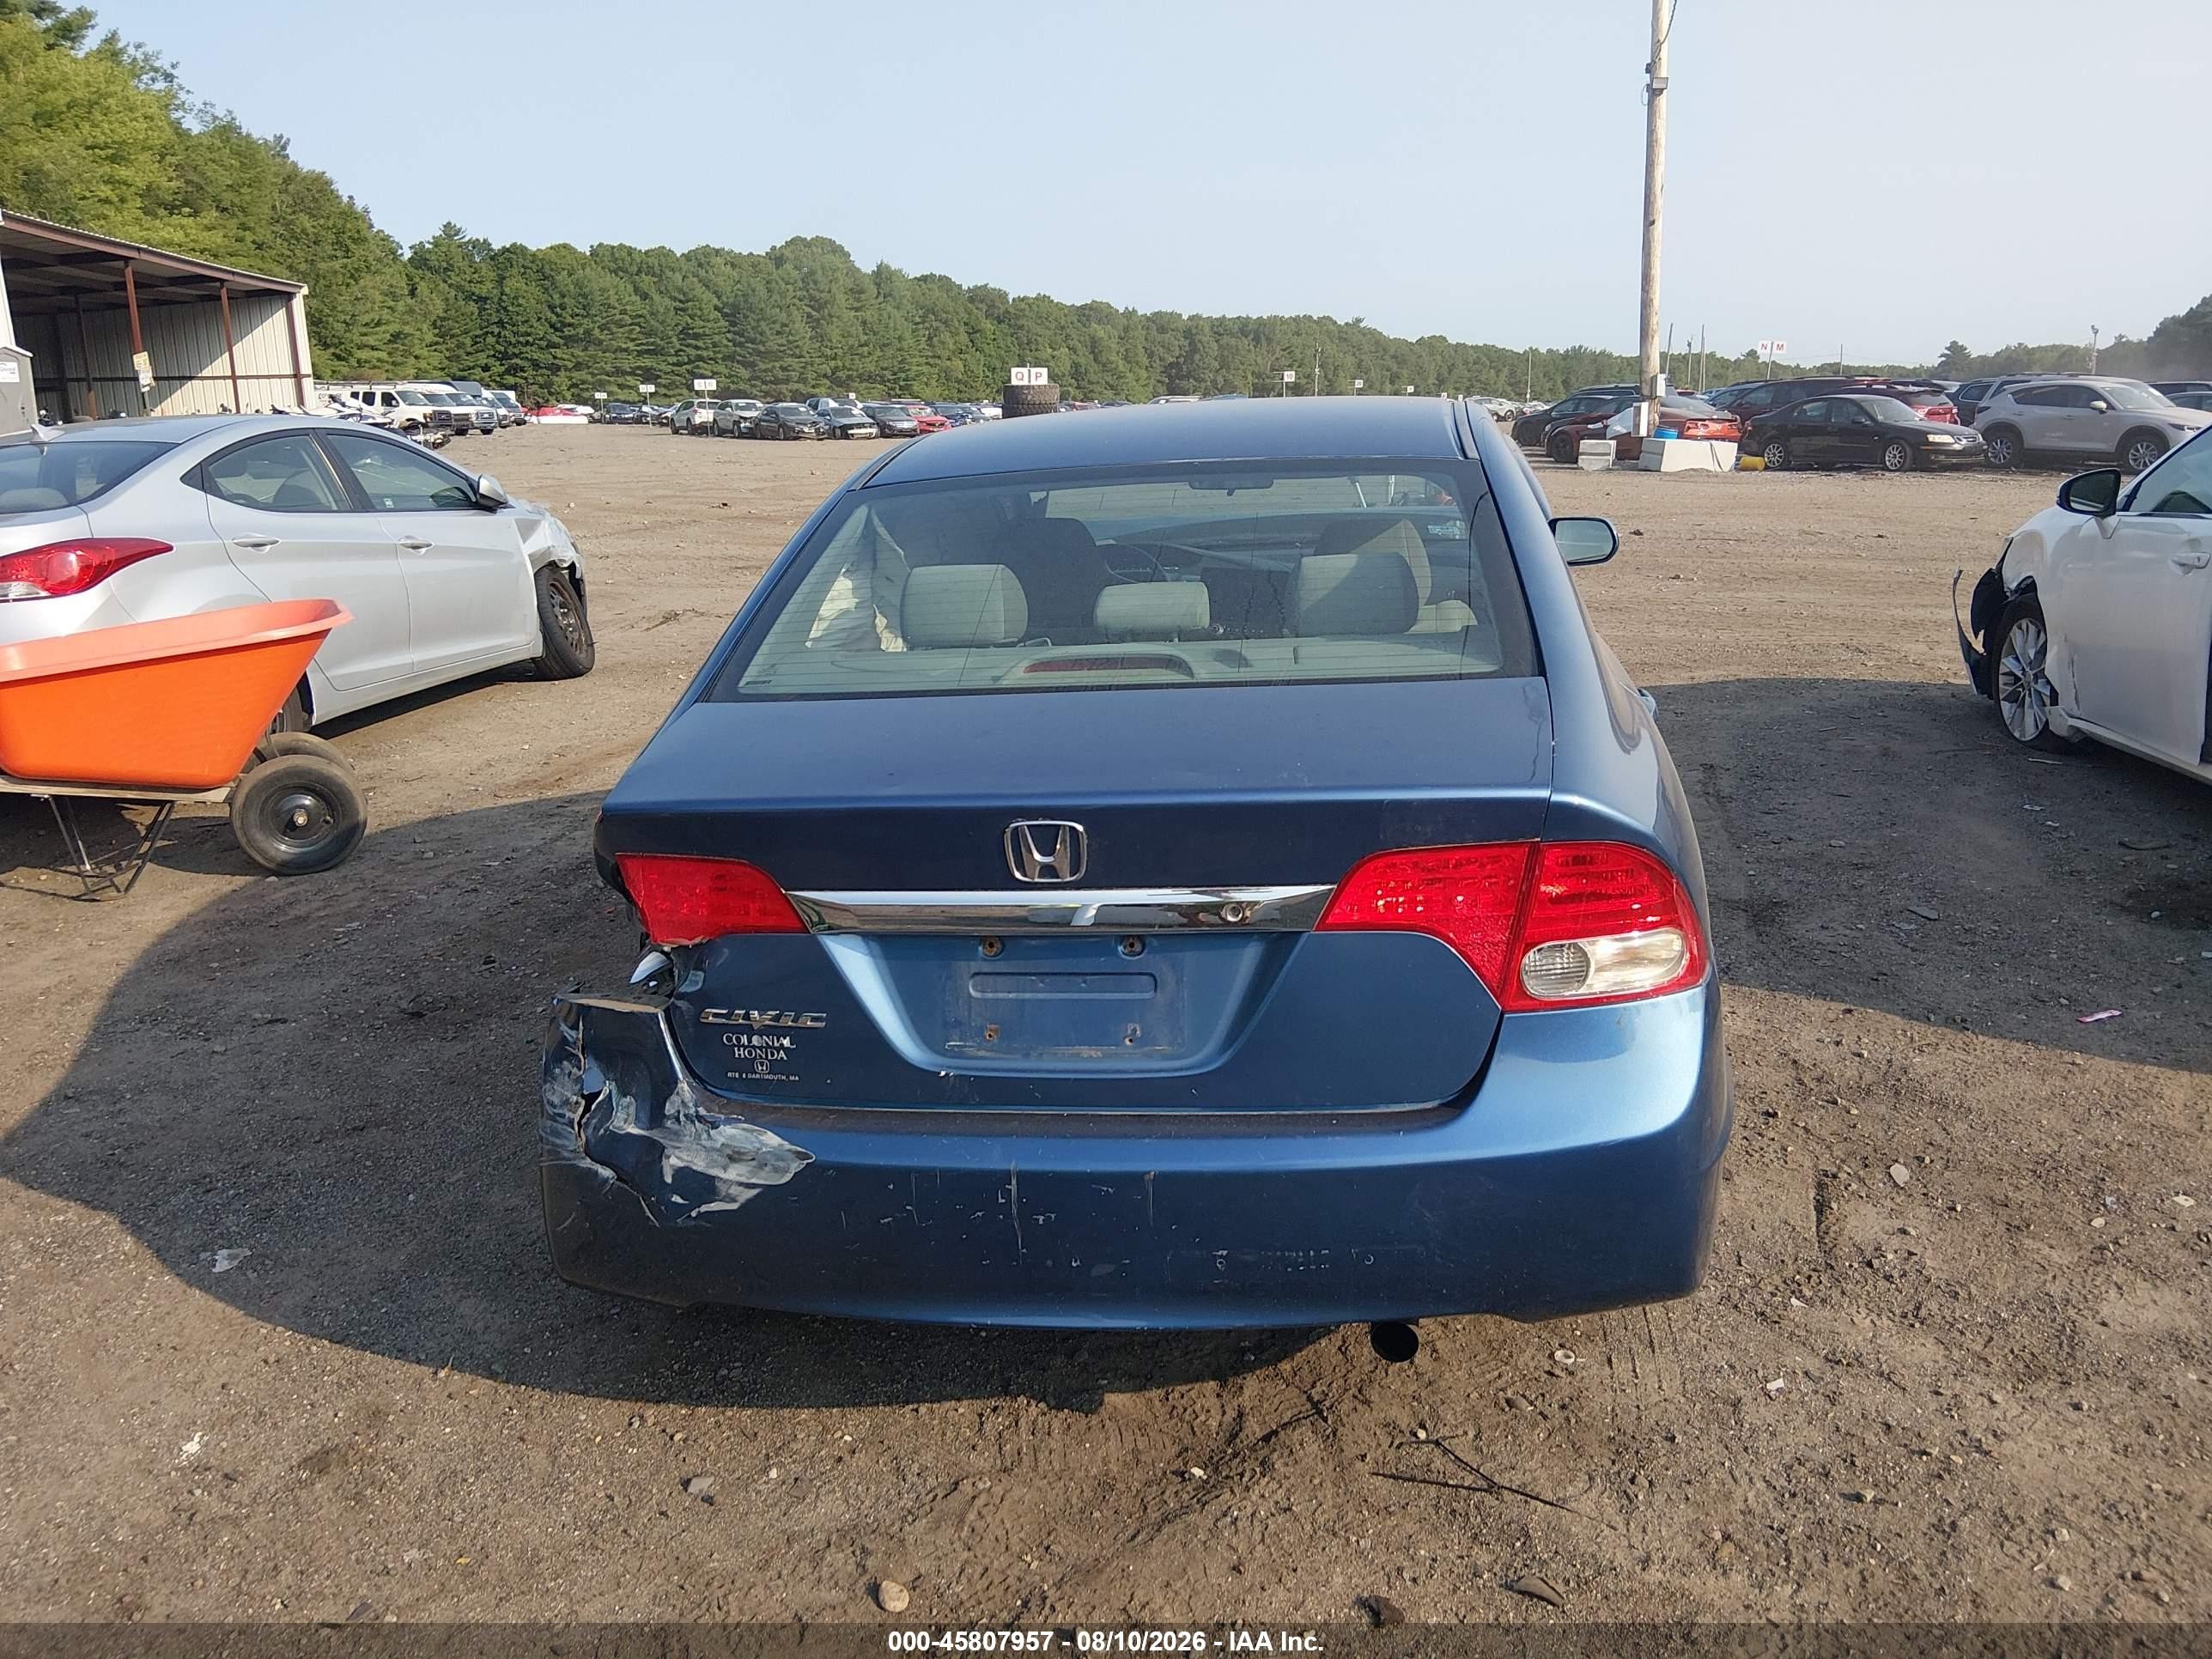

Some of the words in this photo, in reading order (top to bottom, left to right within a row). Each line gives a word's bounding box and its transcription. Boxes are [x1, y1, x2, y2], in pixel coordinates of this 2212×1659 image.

[1015, 371, 1024, 382] Q
[1035, 372, 1042, 381] P
[699, 1008, 827, 1030] CIVIC
[723, 1033, 797, 1048] COLONIAL
[734, 1047, 787, 1060] HONDA
